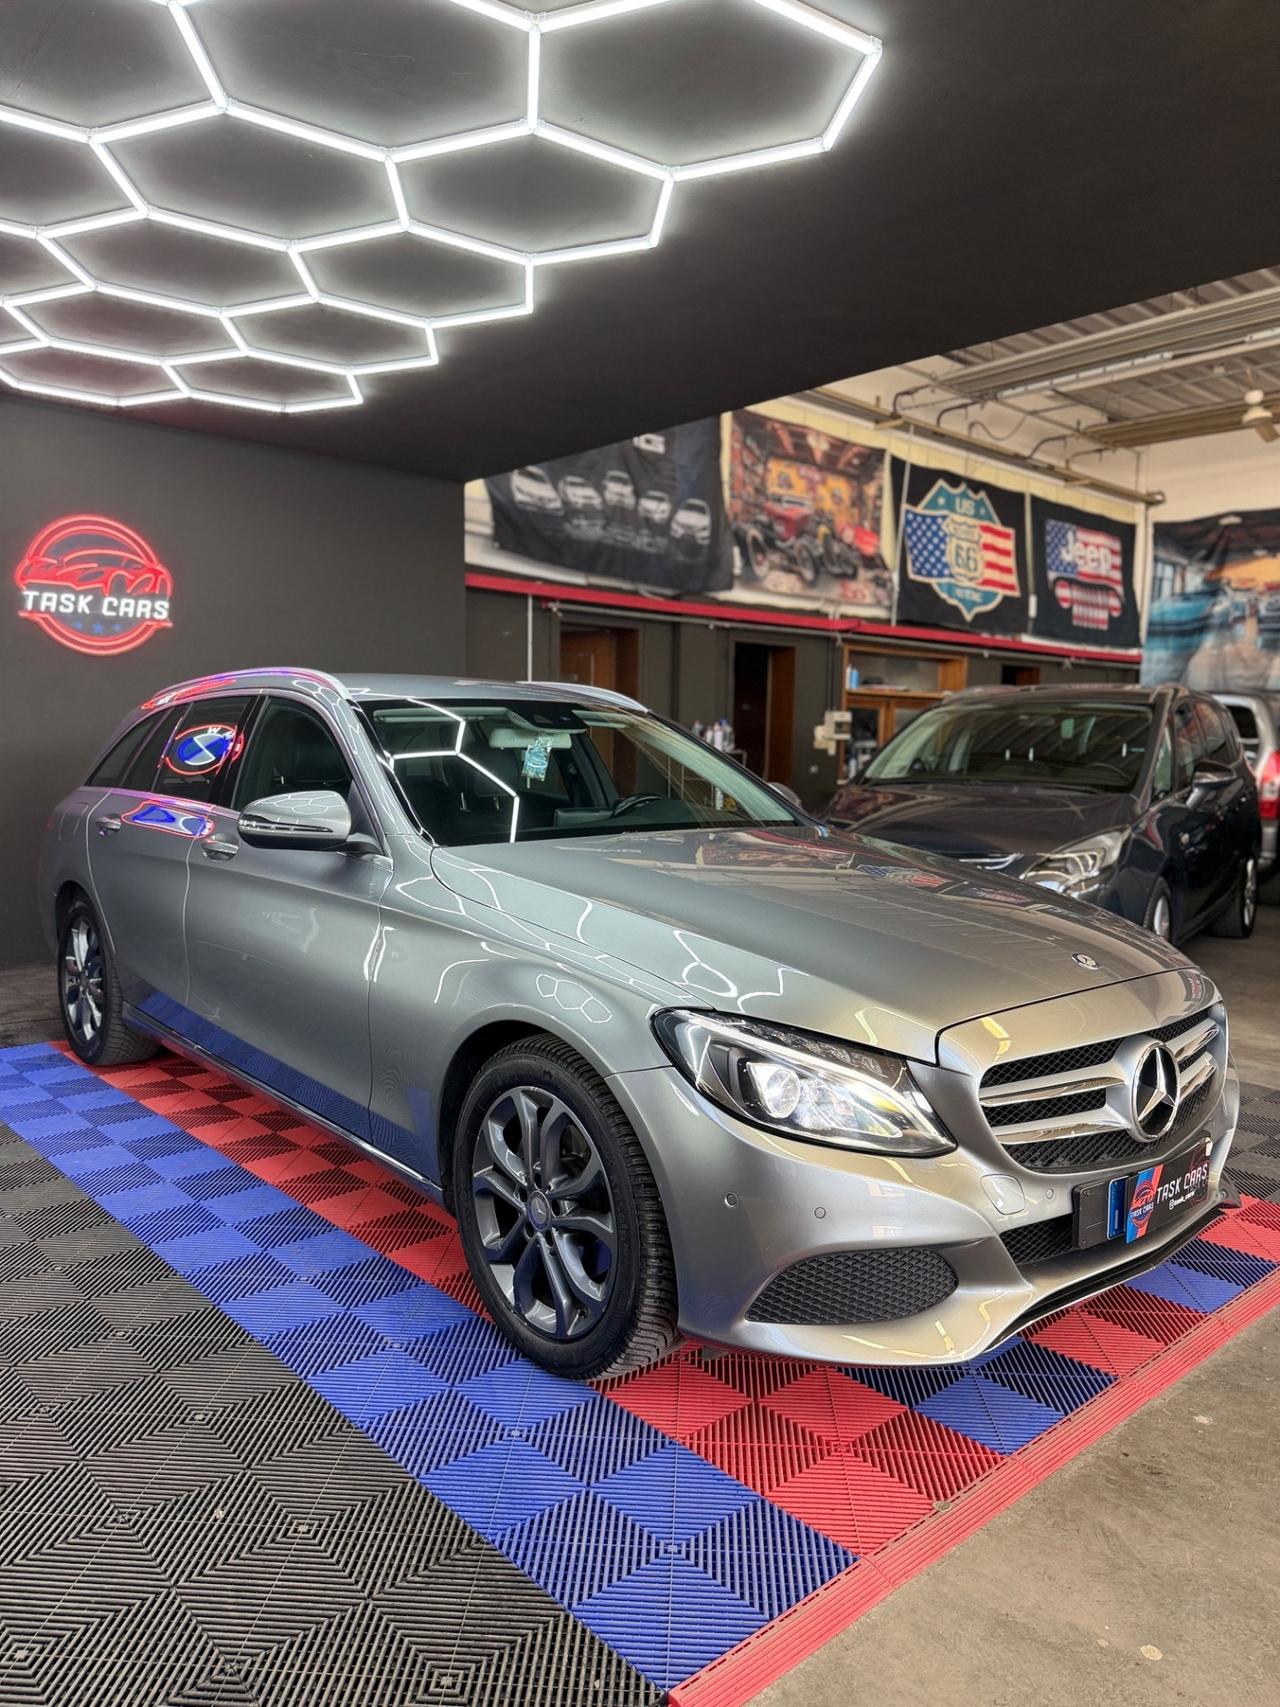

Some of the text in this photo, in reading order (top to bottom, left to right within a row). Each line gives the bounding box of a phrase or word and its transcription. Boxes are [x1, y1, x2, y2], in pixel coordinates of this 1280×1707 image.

[955, 497, 975, 517] US
[955, 542, 977, 573] 66
[1061, 529, 1112, 577] Jeep
[22, 590, 170, 620] TASK CARS
[1157, 1177, 1182, 1204] TASK
[1183, 1163, 1208, 1190] CARS
